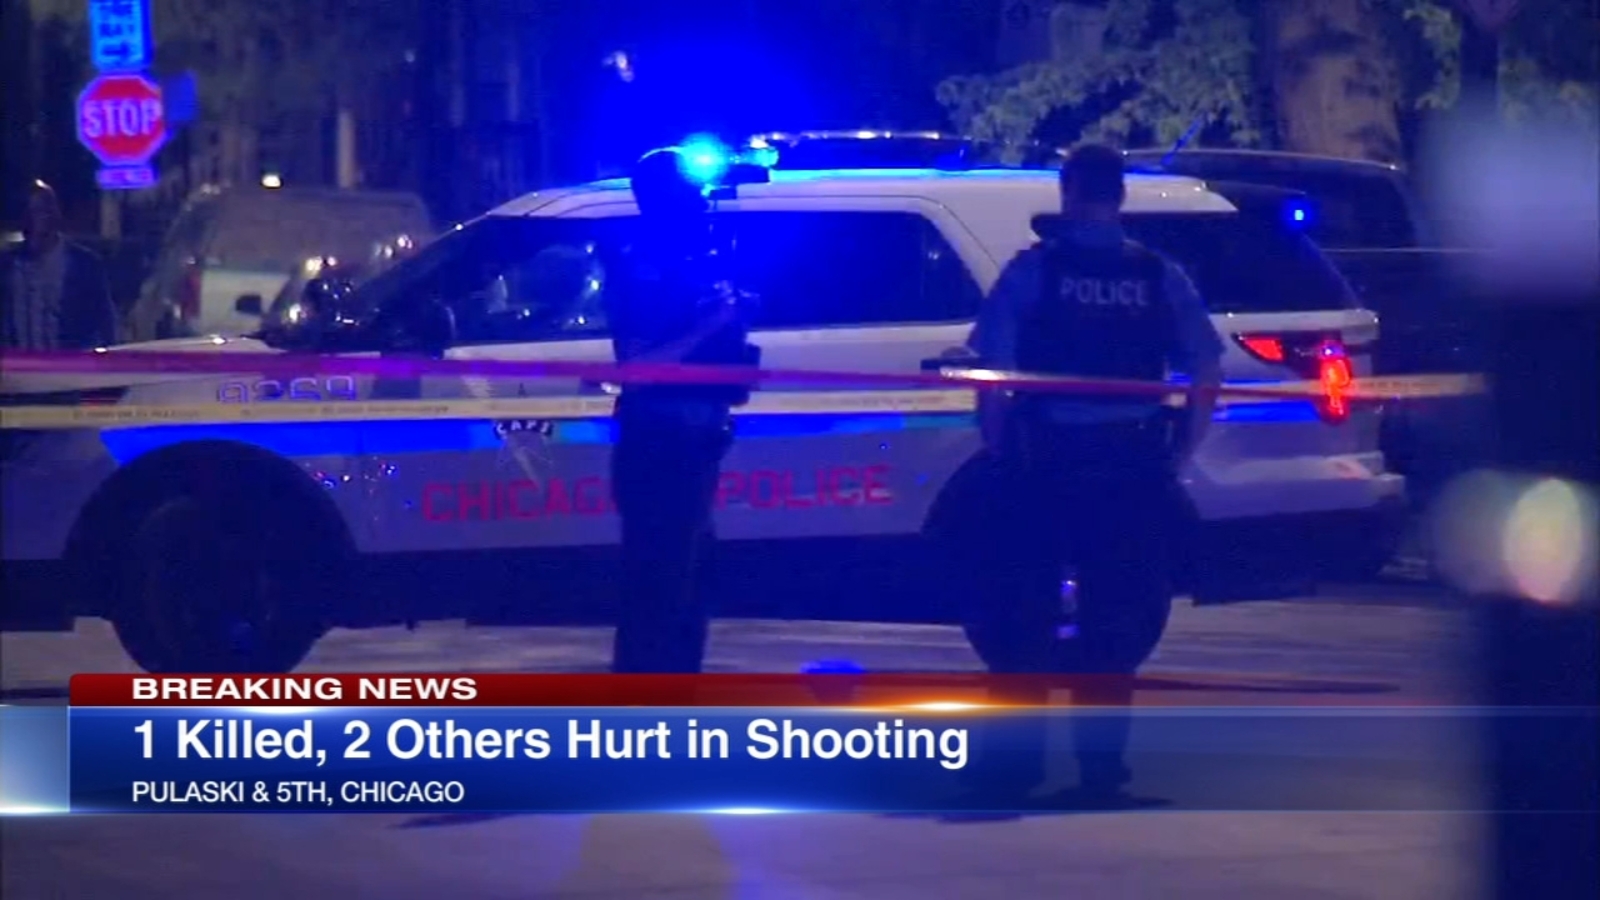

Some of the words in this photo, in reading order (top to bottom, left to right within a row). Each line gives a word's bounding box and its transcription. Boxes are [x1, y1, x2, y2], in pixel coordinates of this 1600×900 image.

[83, 98, 162, 138] STOP
[1060, 276, 1149, 306] POLICE
[421, 475, 616, 522] CHICAG
[713, 464, 894, 511] POLICE
